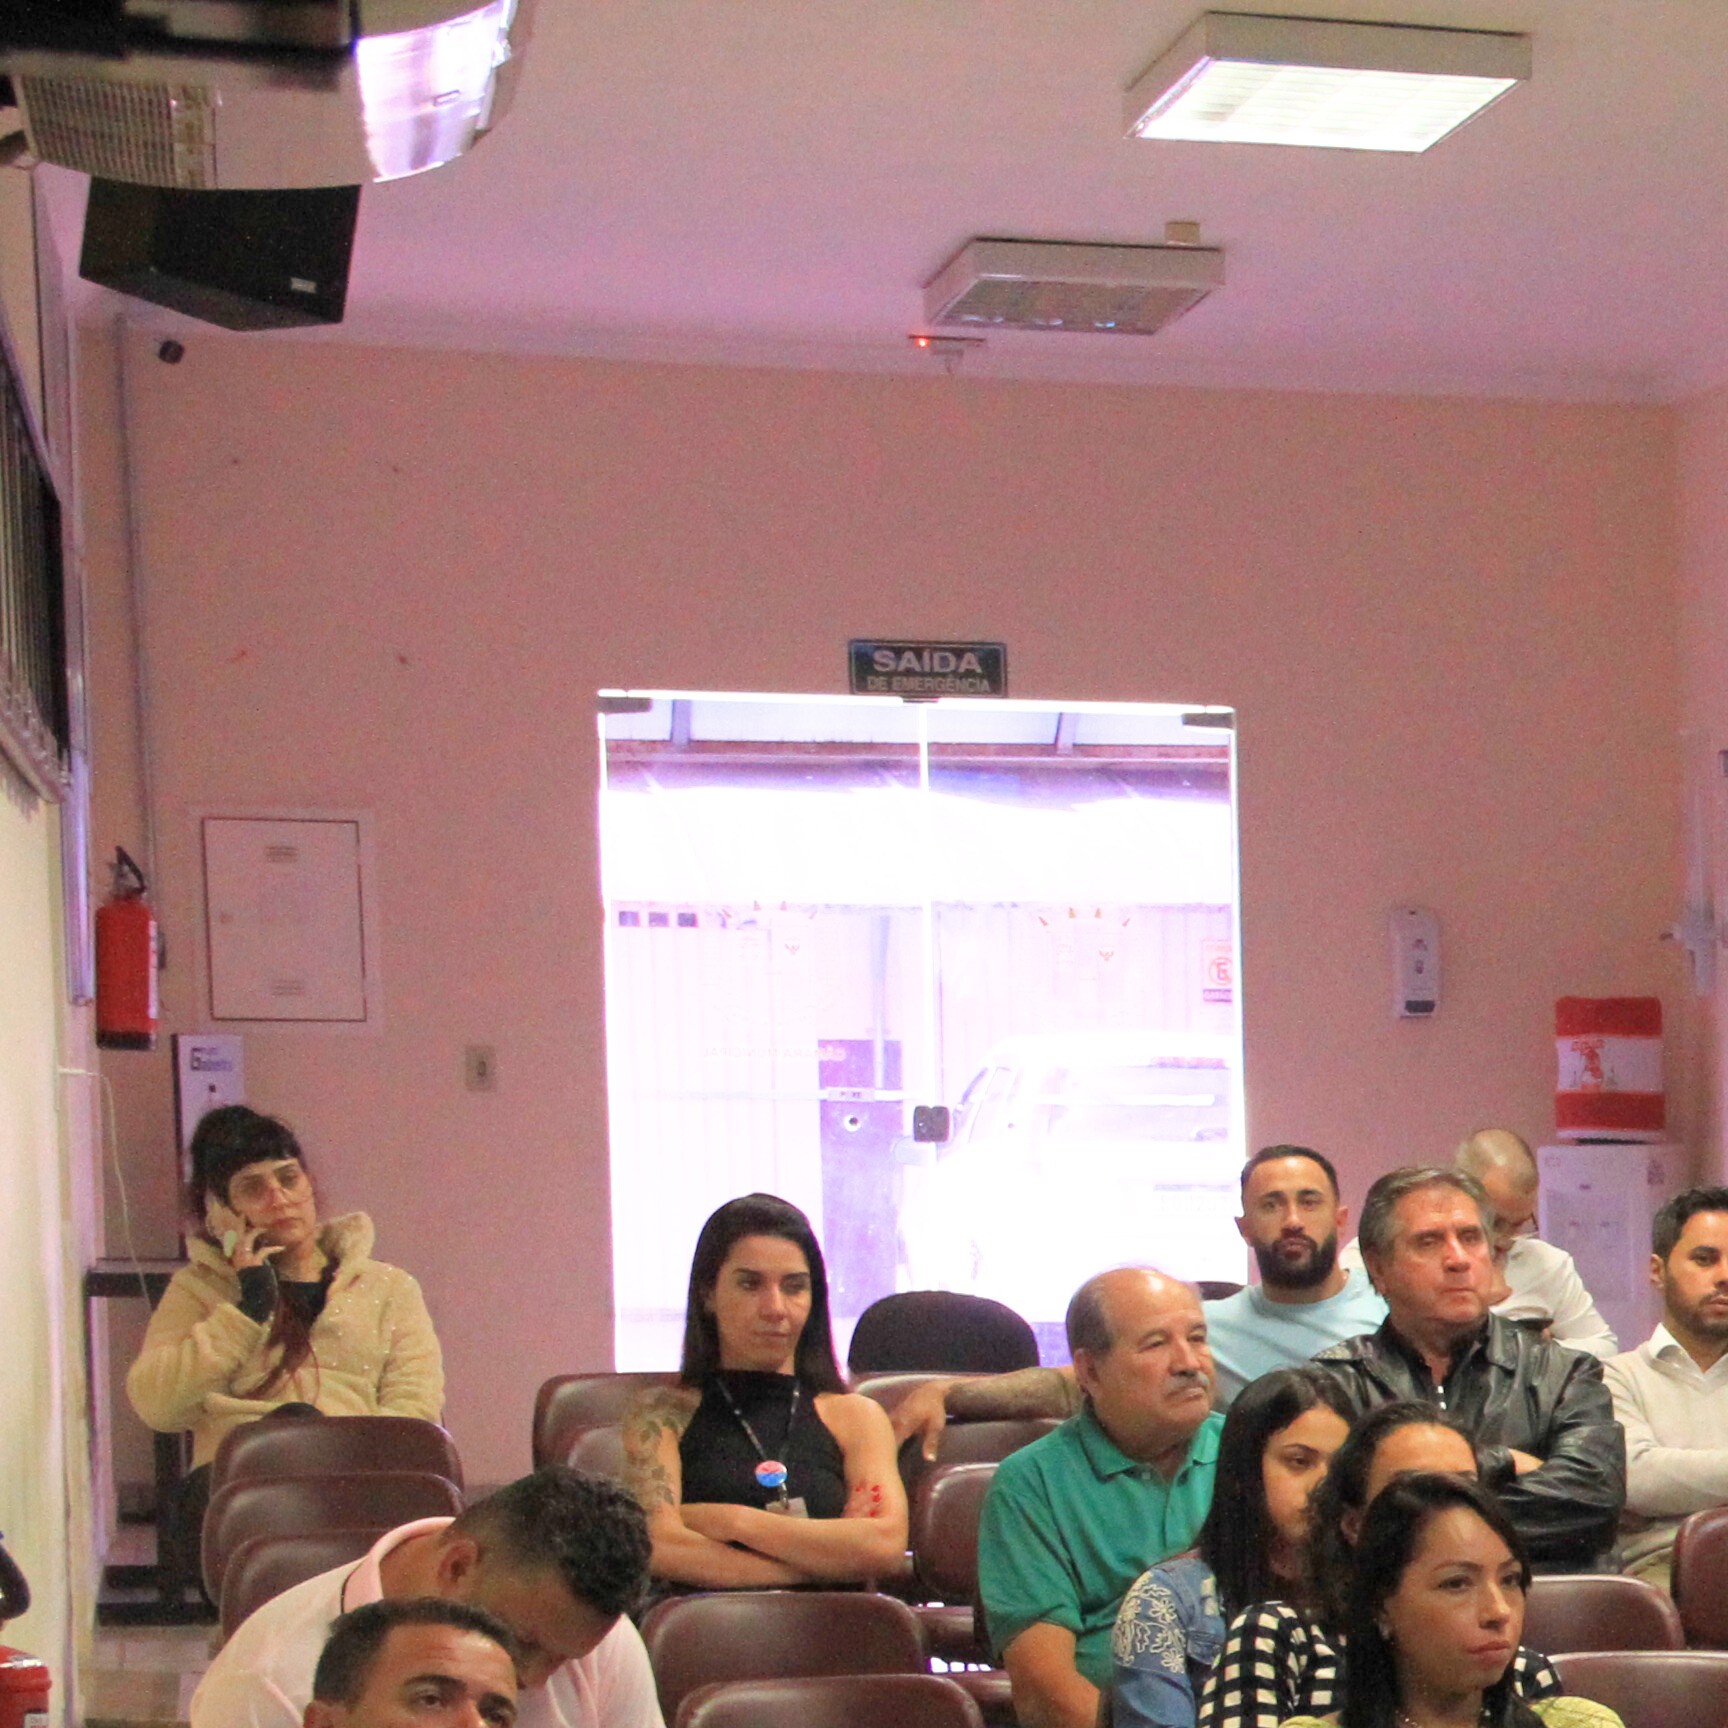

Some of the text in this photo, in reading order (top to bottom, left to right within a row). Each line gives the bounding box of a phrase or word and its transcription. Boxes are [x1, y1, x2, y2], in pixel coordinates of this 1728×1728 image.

[872, 648, 983, 674] SAÍDA
[866, 674, 991, 693] DE EMERGÊNCIA
